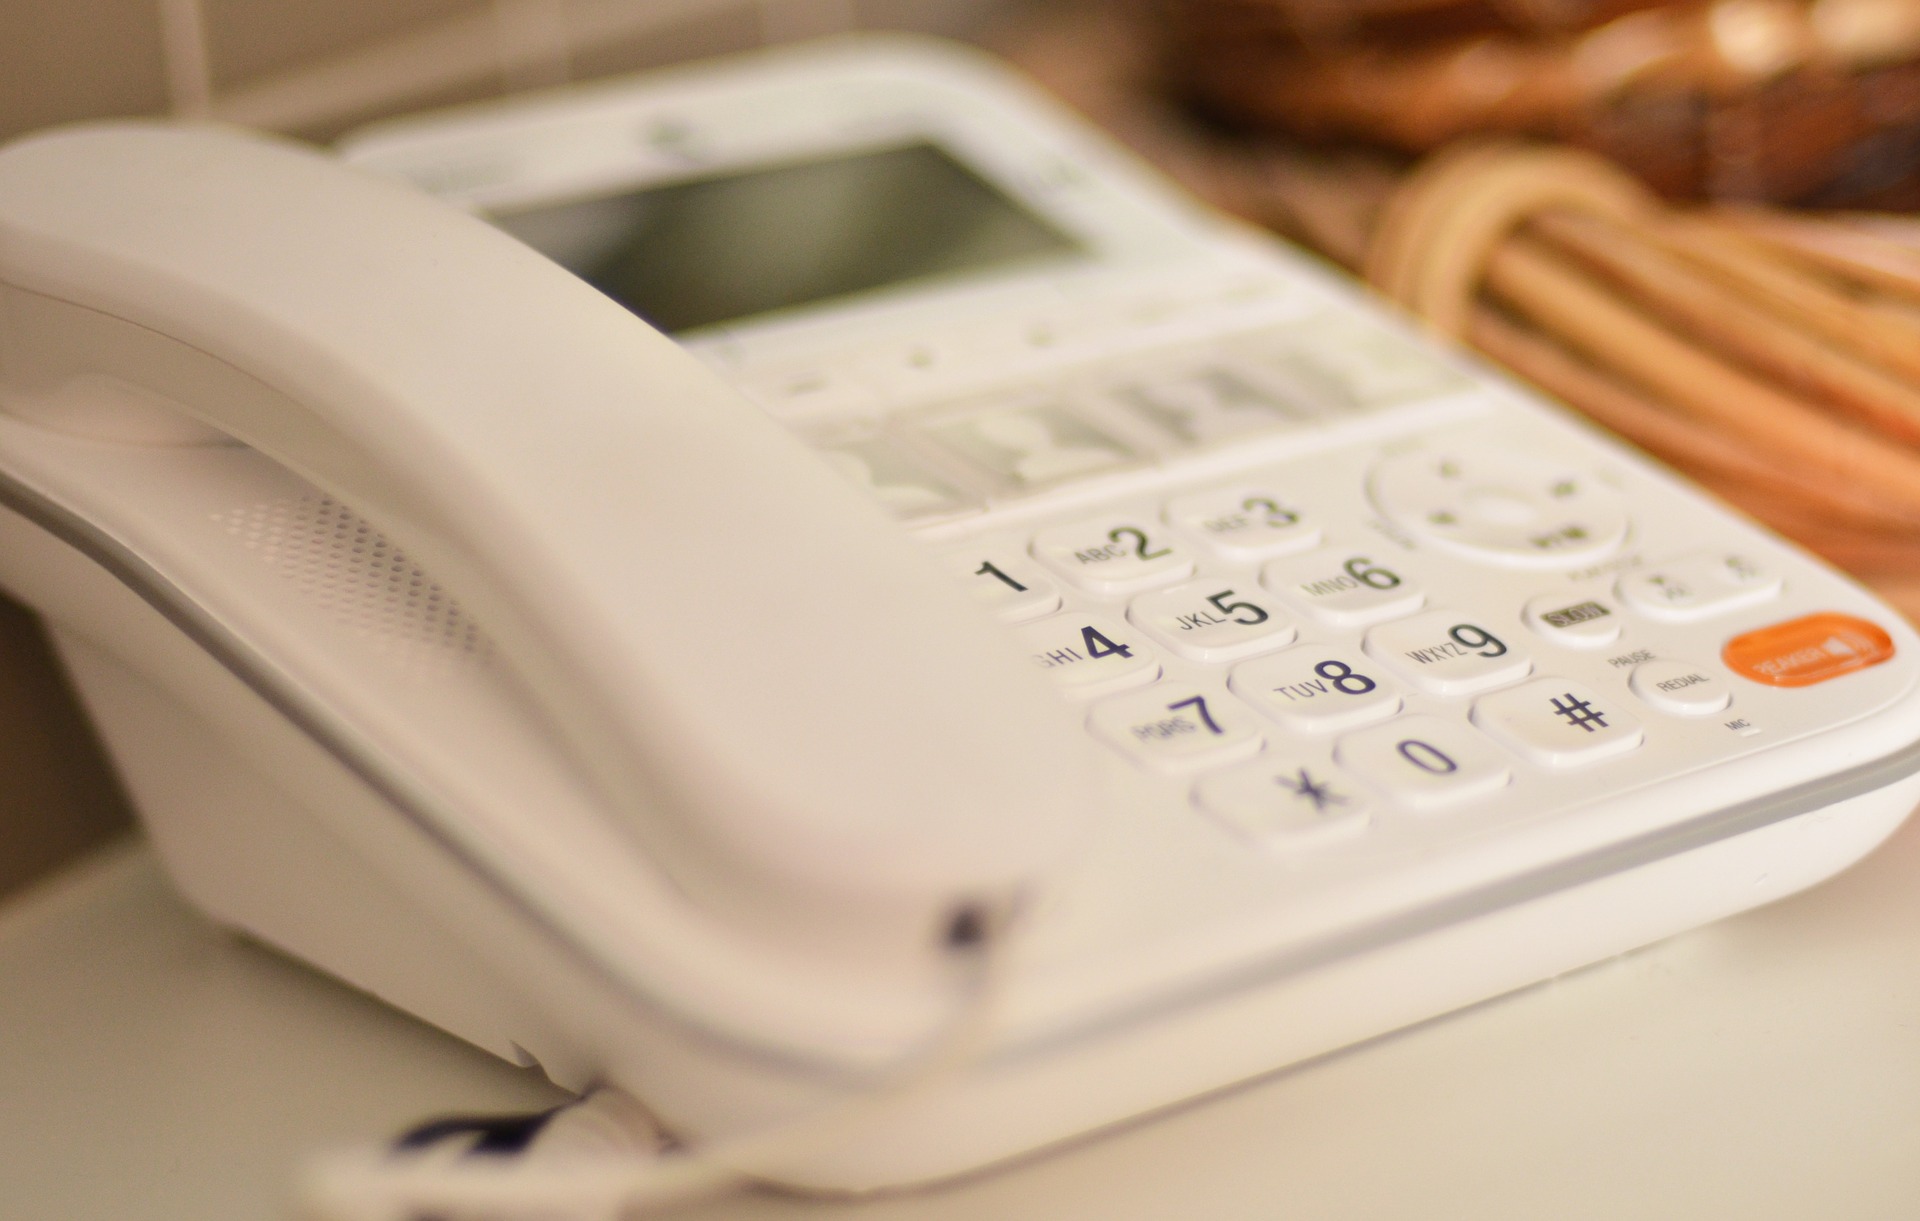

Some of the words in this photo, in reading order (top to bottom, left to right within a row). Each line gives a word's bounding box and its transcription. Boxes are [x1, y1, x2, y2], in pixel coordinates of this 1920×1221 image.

[1242, 497, 1300, 529] 3
[1074, 544, 1127, 565] ABC
[1107, 526, 1174, 561] 2
[974, 561, 1028, 592] 1
[1300, 575, 1359, 597] MNO
[1342, 556, 1402, 590] 6
[1175, 609, 1226, 631] JKL
[1204, 589, 1269, 626] 5
[1549, 605, 1603, 626] SLOW
[1080, 625, 1135, 660] 4
[1405, 642, 1468, 664] WXYZ
[1447, 623, 1507, 658] 9
[1607, 648, 1656, 669] PAUSE
[1272, 679, 1329, 701] TUV
[1313, 660, 1376, 695] 8
[1655, 672, 1710, 693] REDIAL
[1166, 694, 1227, 738] 7
[1724, 718, 1750, 731] MIC
[1395, 738, 1459, 776] 0
